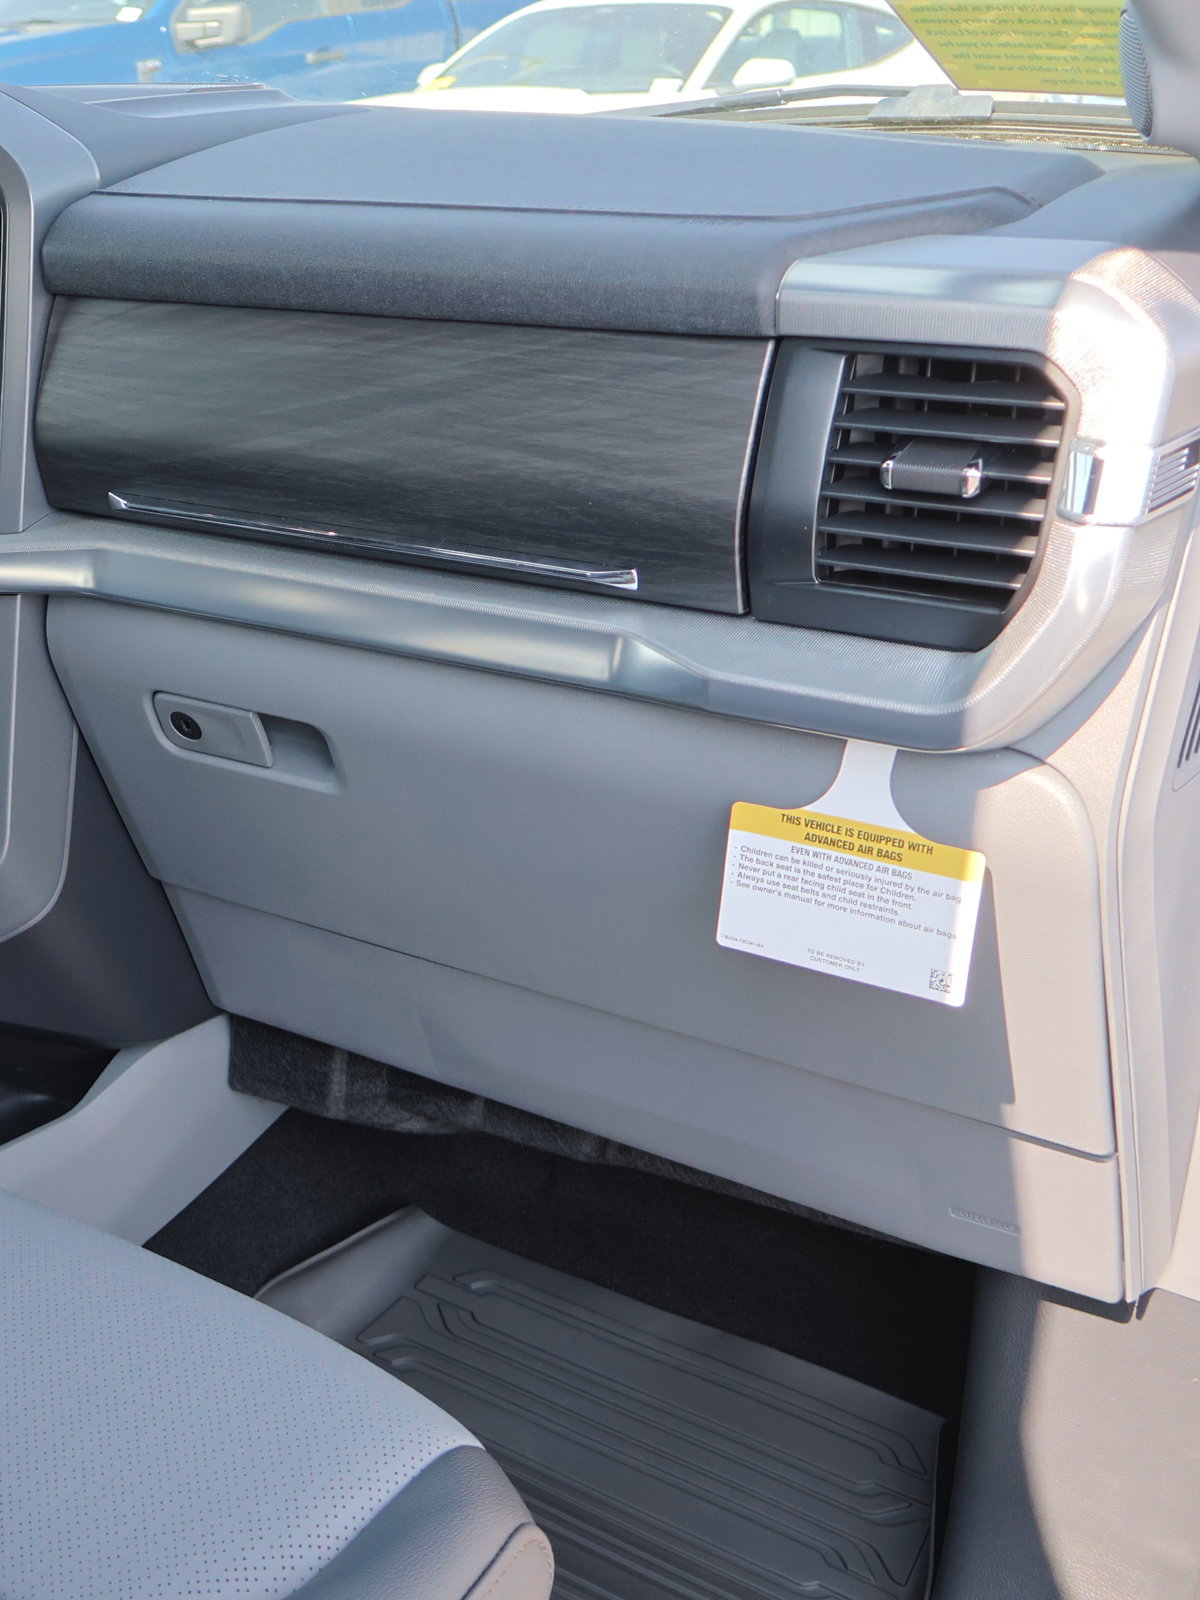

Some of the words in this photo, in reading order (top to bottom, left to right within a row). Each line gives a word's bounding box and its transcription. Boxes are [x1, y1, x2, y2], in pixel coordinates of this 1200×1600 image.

[781, 813, 801, 826] THIS
[804, 818, 843, 835] VEHICLE
[845, 827, 854, 838] IS
[857, 830, 904, 849] EQUIPPED
[907, 840, 934, 855] WITH
[804, 832, 855, 851] ADVANCED
[857, 844, 874, 856] AIR
[876, 848, 903, 863] BAGS
[739, 854, 754, 863] The
[755, 857, 774, 867] back
[776, 862, 792, 872] seat
[794, 866, 801, 874] is
[802, 867, 815, 877] the
[817, 871, 841, 883] safest
[843, 878, 864, 889] place
[866, 882, 878, 892] for
[880, 886, 917, 902] Children.
[740, 845, 773, 857] Children
[774, 854, 789, 862] can
[791, 856, 801, 864] be
[802, 858, 823, 870] killed
[825, 864, 834, 872] or
[835, 867, 872, 883] seriously
[874, 875, 903, 888] injured
[905, 883, 915, 893] by
[917, 886, 931, 896] the
[932, 890, 943, 898] air
[791, 845, 810, 857] EVEN
[812, 850, 832, 861] WITH
[834, 855, 873, 871] ADVANCED
[876, 864, 889, 875] AIR
[891, 868, 913, 881] BAGS
[737, 871, 765, 884] Always
[766, 878, 781, 887] use
[782, 881, 799, 891] seat
[800, 885, 820, 897] belts
[821, 890, 837, 901] and
[838, 894, 858, 906] child
[738, 862, 761, 874] Never
[762, 868, 775, 878] put
[783, 873, 798, 882] rear
[800, 876, 825, 891] facing
[827, 882, 847, 894] child
[848, 888, 865, 899] seat
[867, 891, 875, 901] in
[876, 894, 890, 904] the
[736, 879, 751, 889] See
[752, 884, 782, 897] owner's
[783, 891, 813, 904] manual
[814, 898, 825, 907] for
[827, 903, 848, 913] more
[849, 906, 896, 924] information
[897, 920, 921, 931] about
[923, 925, 934, 934] air
[809, 955, 843, 969] CUSTOMER
[844, 963, 861, 973] ONLY
[816, 949, 825, 957] BE
[826, 952, 856, 966] REMOVED
